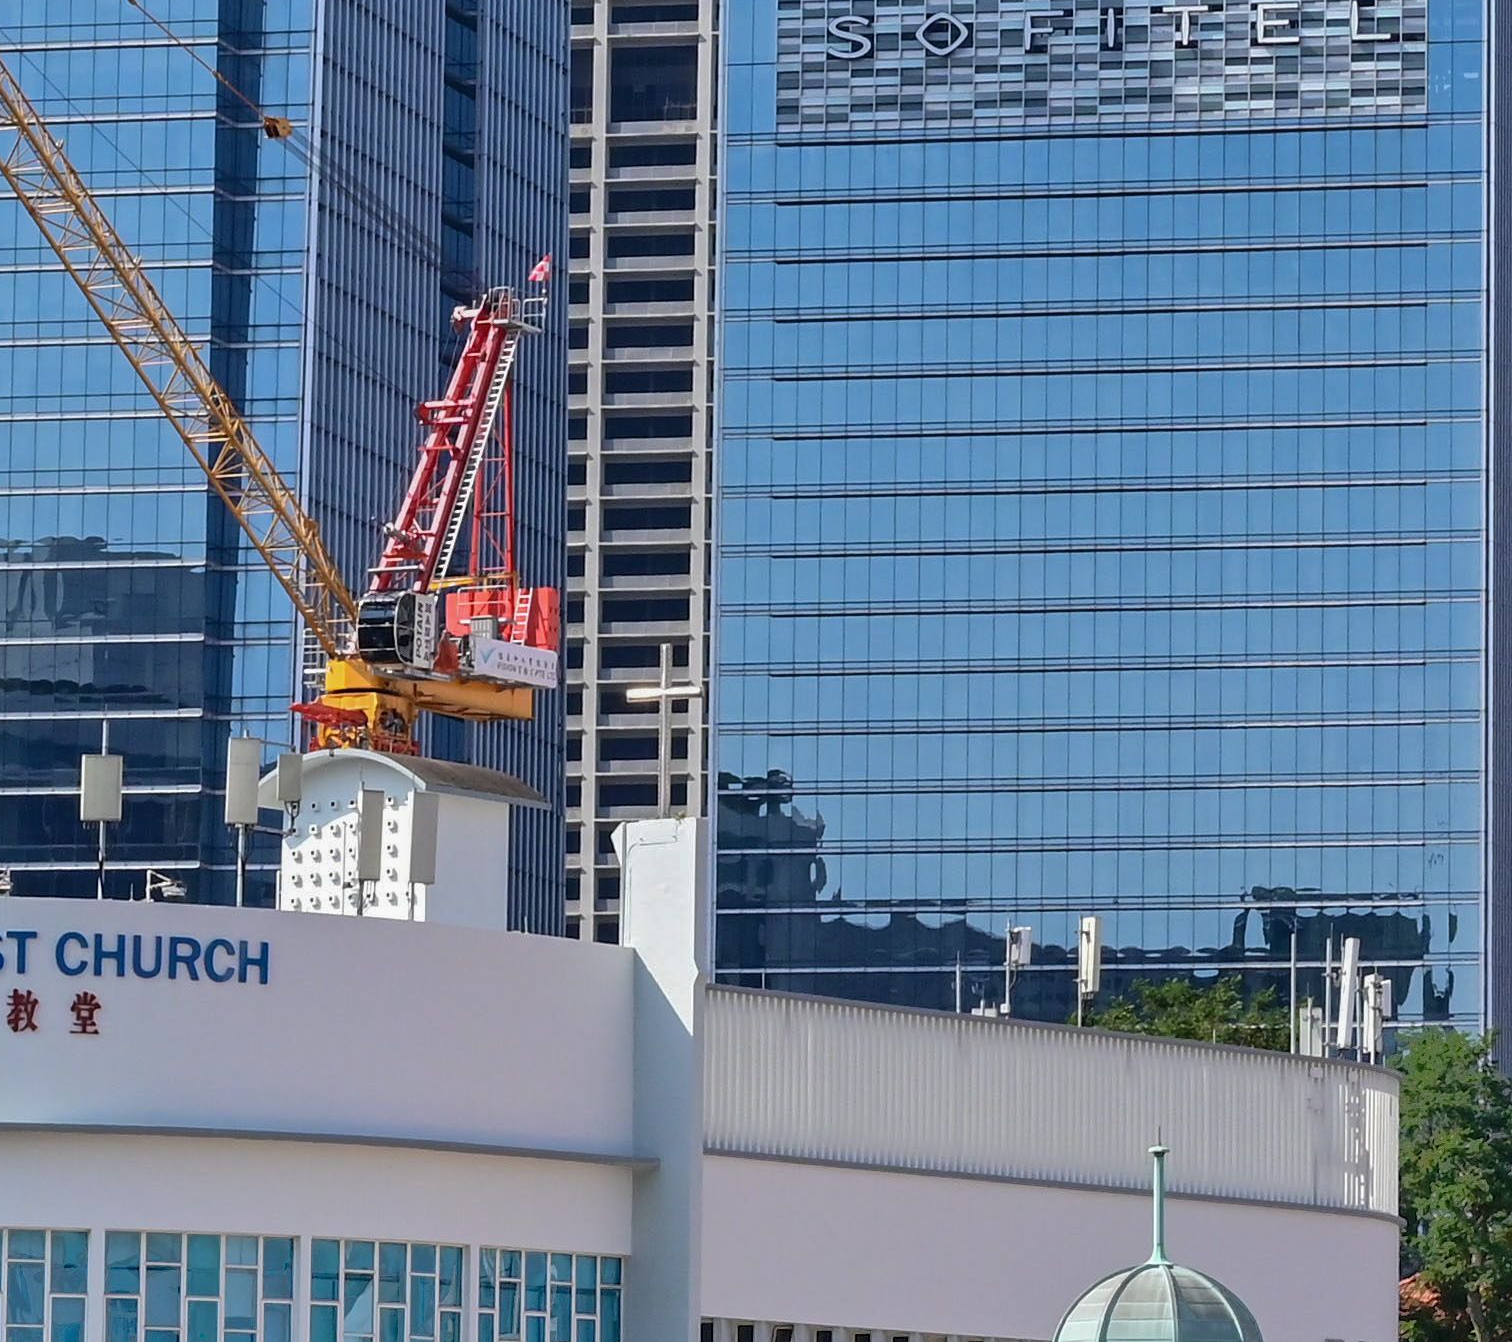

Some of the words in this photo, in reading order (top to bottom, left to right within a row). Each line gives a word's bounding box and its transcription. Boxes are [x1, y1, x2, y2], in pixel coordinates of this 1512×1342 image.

[827, 0, 1392, 60] SOFITEL
[416, 602, 424, 658] POTAIN
[55, 932, 270, 985] CHURCH
